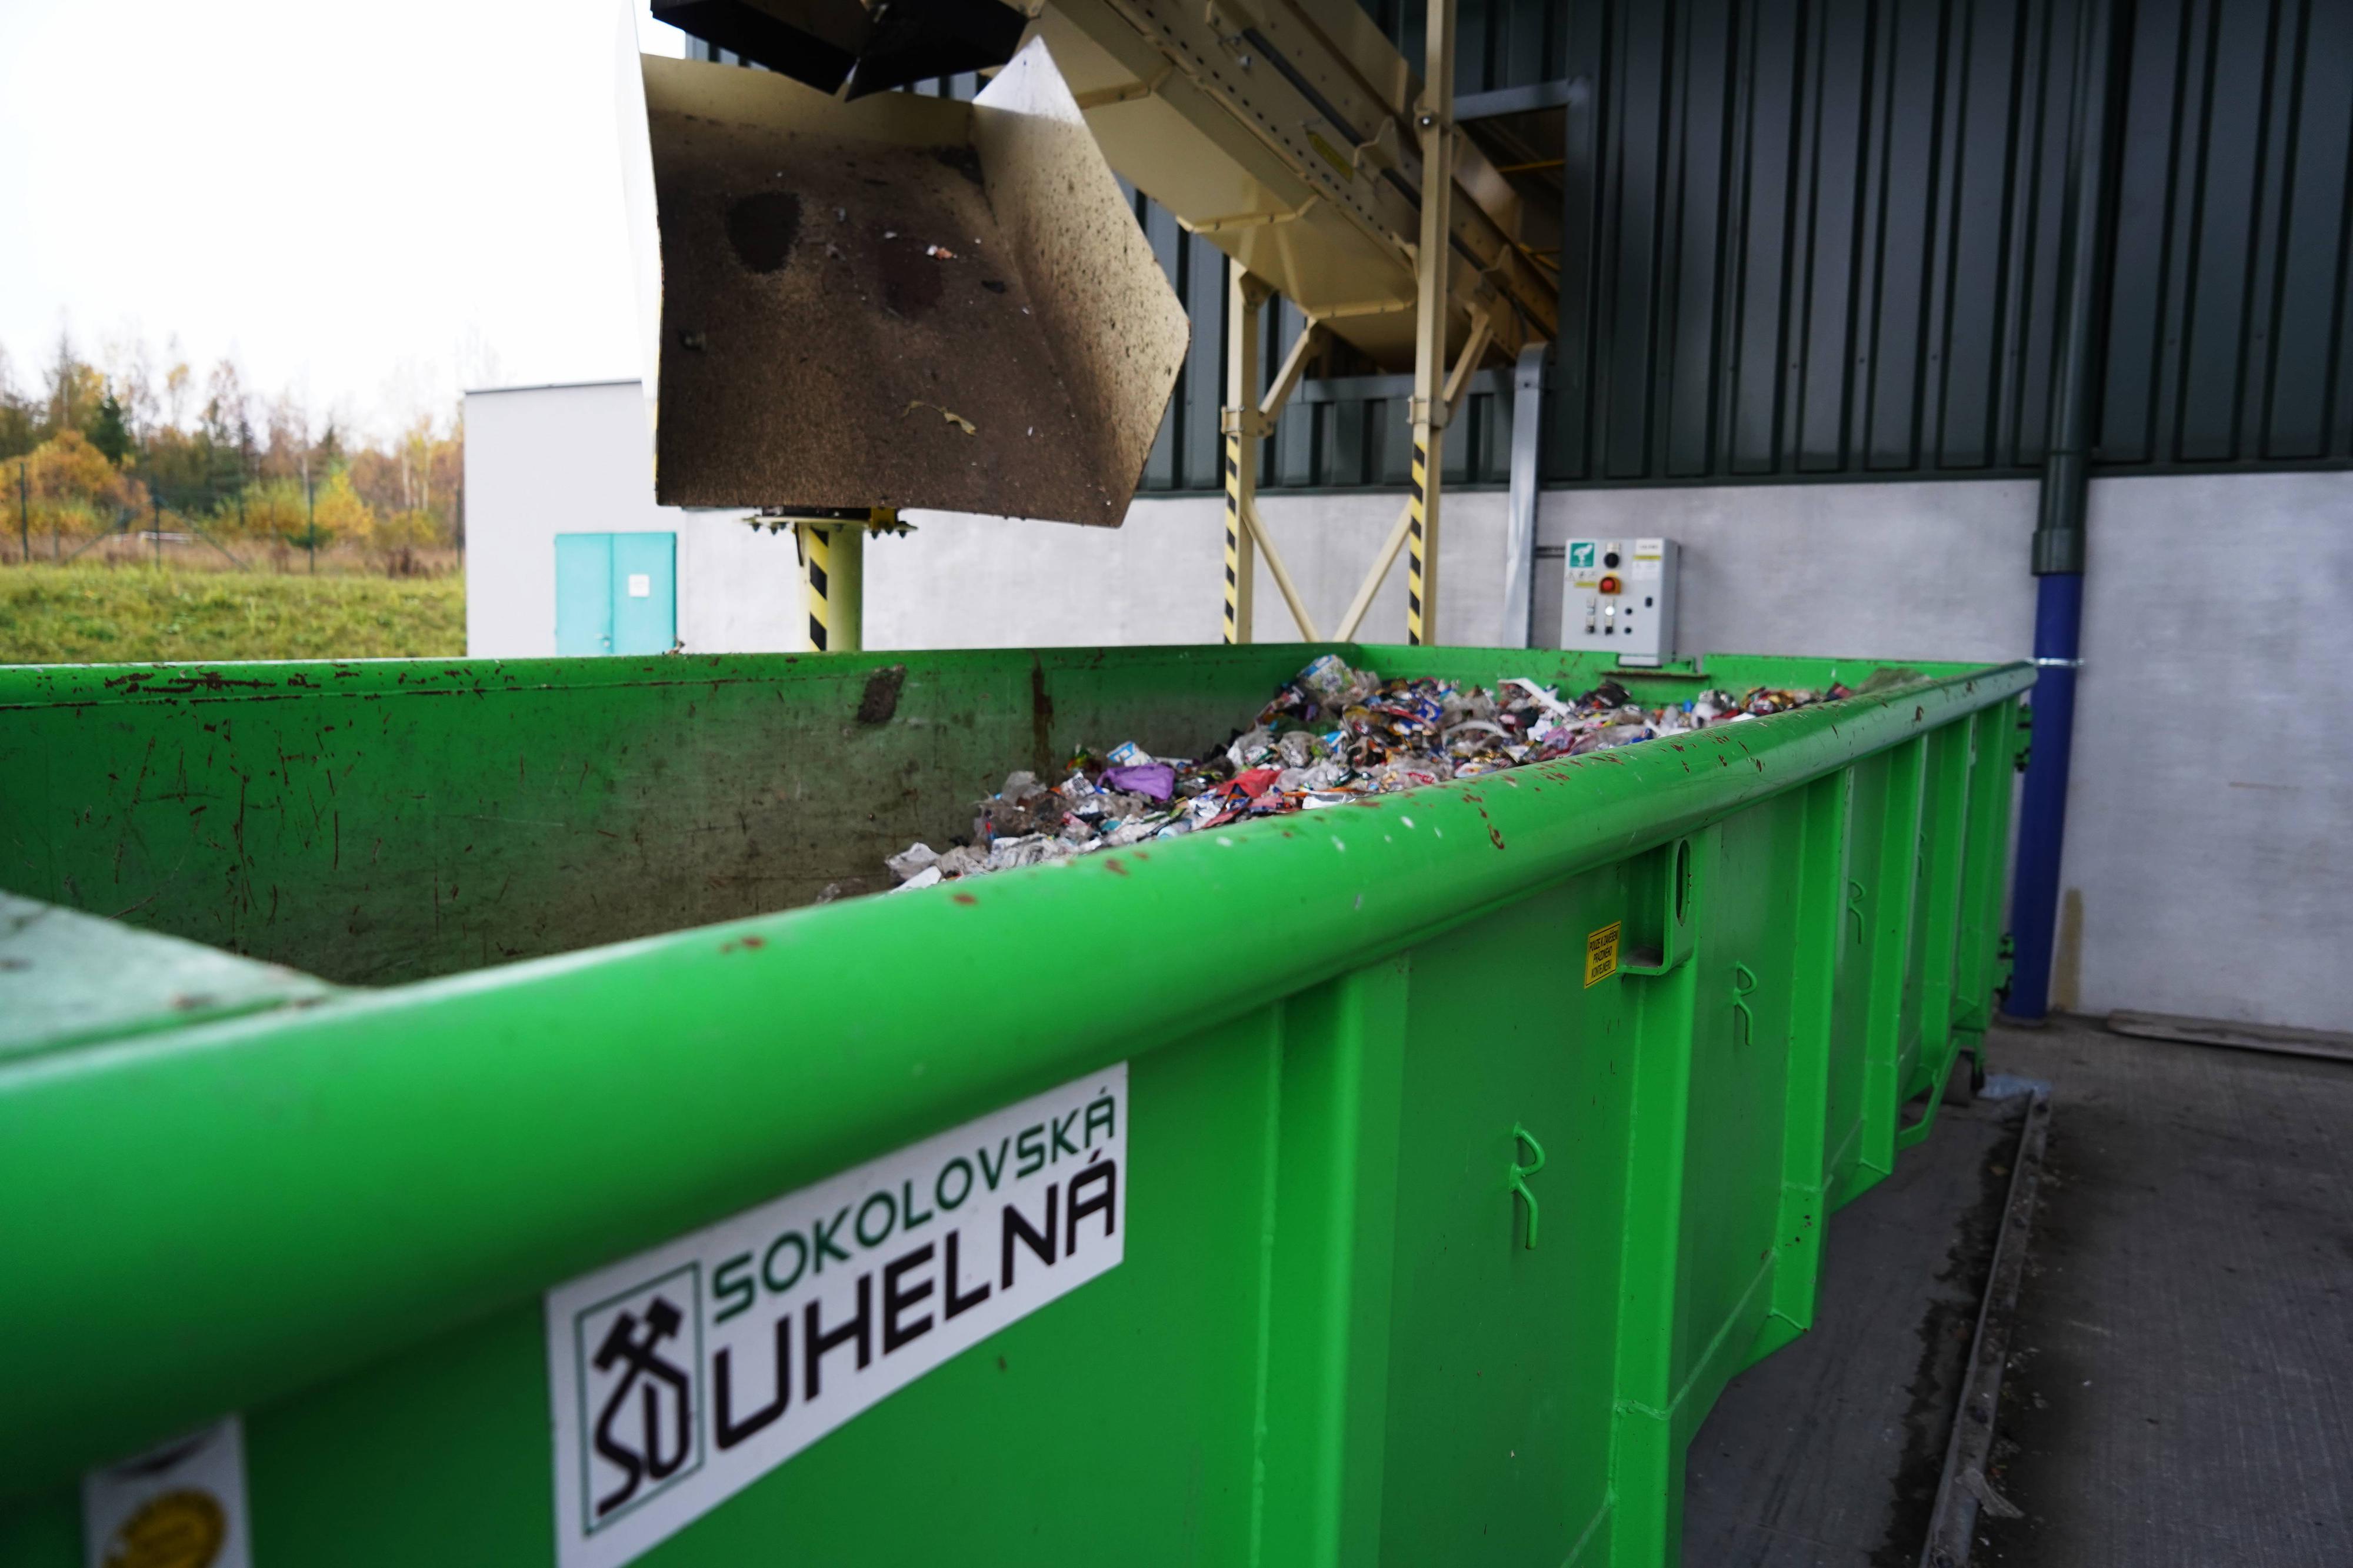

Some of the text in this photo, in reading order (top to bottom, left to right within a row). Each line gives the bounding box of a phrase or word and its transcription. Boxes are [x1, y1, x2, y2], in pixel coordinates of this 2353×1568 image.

[1589, 938, 1600, 952] POUZE
[713, 1148, 1117, 1452] UHELNÁ
[714, 1087, 1115, 1326] SOKOLOVSKÁ
